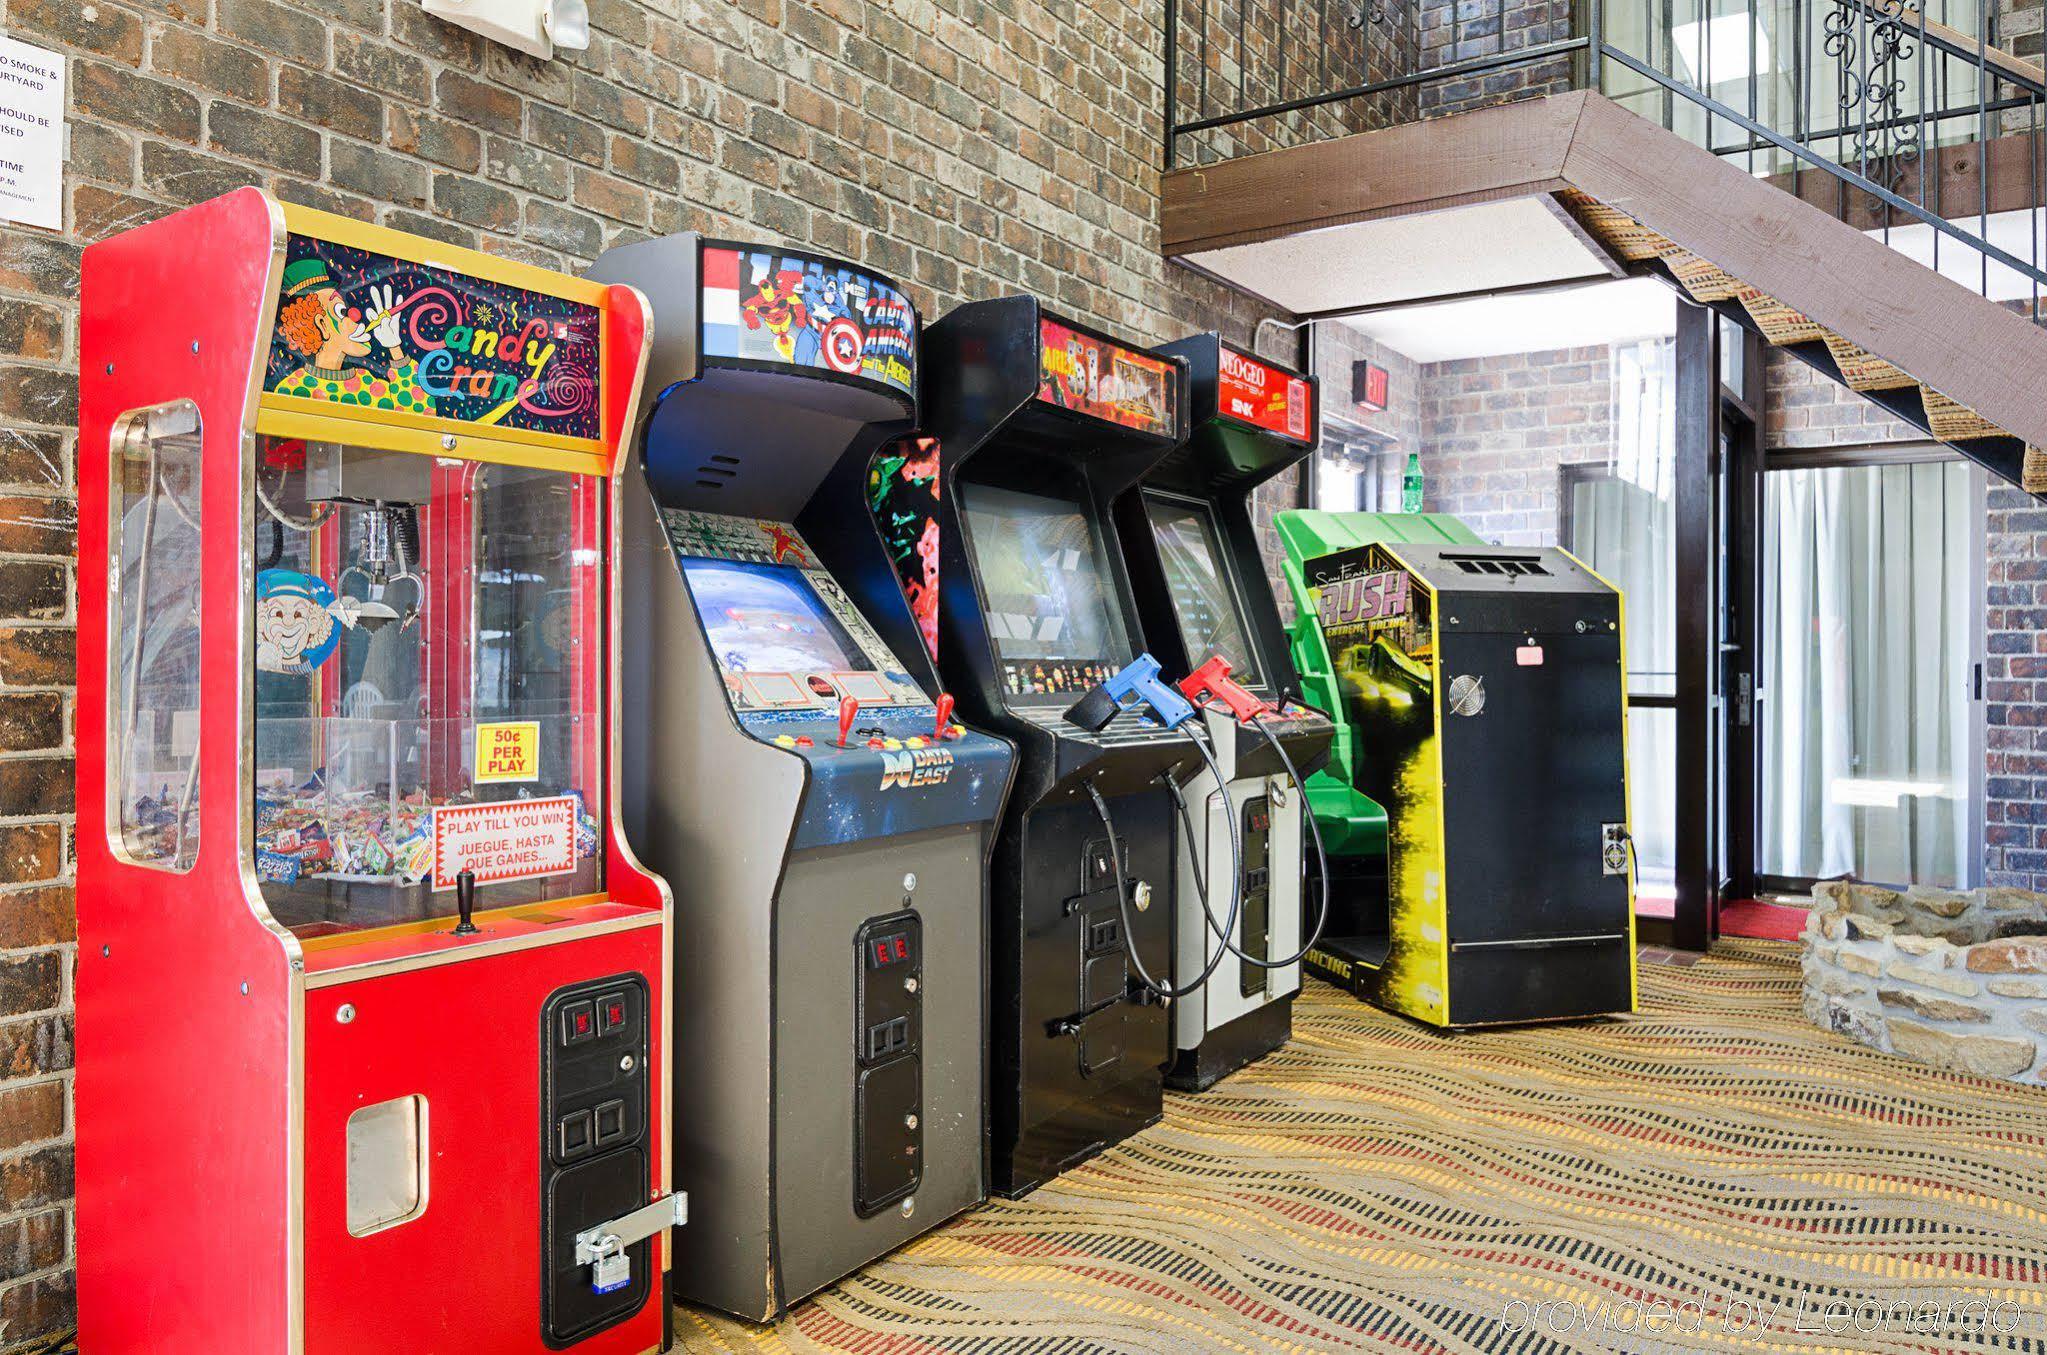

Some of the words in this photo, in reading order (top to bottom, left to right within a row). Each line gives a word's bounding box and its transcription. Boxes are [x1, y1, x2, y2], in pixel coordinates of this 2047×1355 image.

[10, 59, 47, 77] SMOKE
[49, 71, 58, 80] &
[0, 124, 24, 138] ISED
[38, 117, 50, 128] BE
[409, 286, 556, 384] Candy
[418, 349, 578, 416] Crane
[1231, 398, 1254, 418] SNK
[1320, 569, 1409, 625] RUSH
[495, 730, 521, 743] 50¢
[493, 747, 522, 759] PER
[911, 748, 954, 767] DATA
[488, 759, 527, 773] PLAY
[911, 765, 953, 787] EAST
[448, 820, 481, 835] PLAY
[485, 818, 510, 831] TILL
[514, 815, 539, 828] YOU
[542, 812, 564, 825] WIN
[516, 834, 555, 849] HASTA
[466, 856, 493, 870] QUE
[496, 851, 548, 866] GANES...
